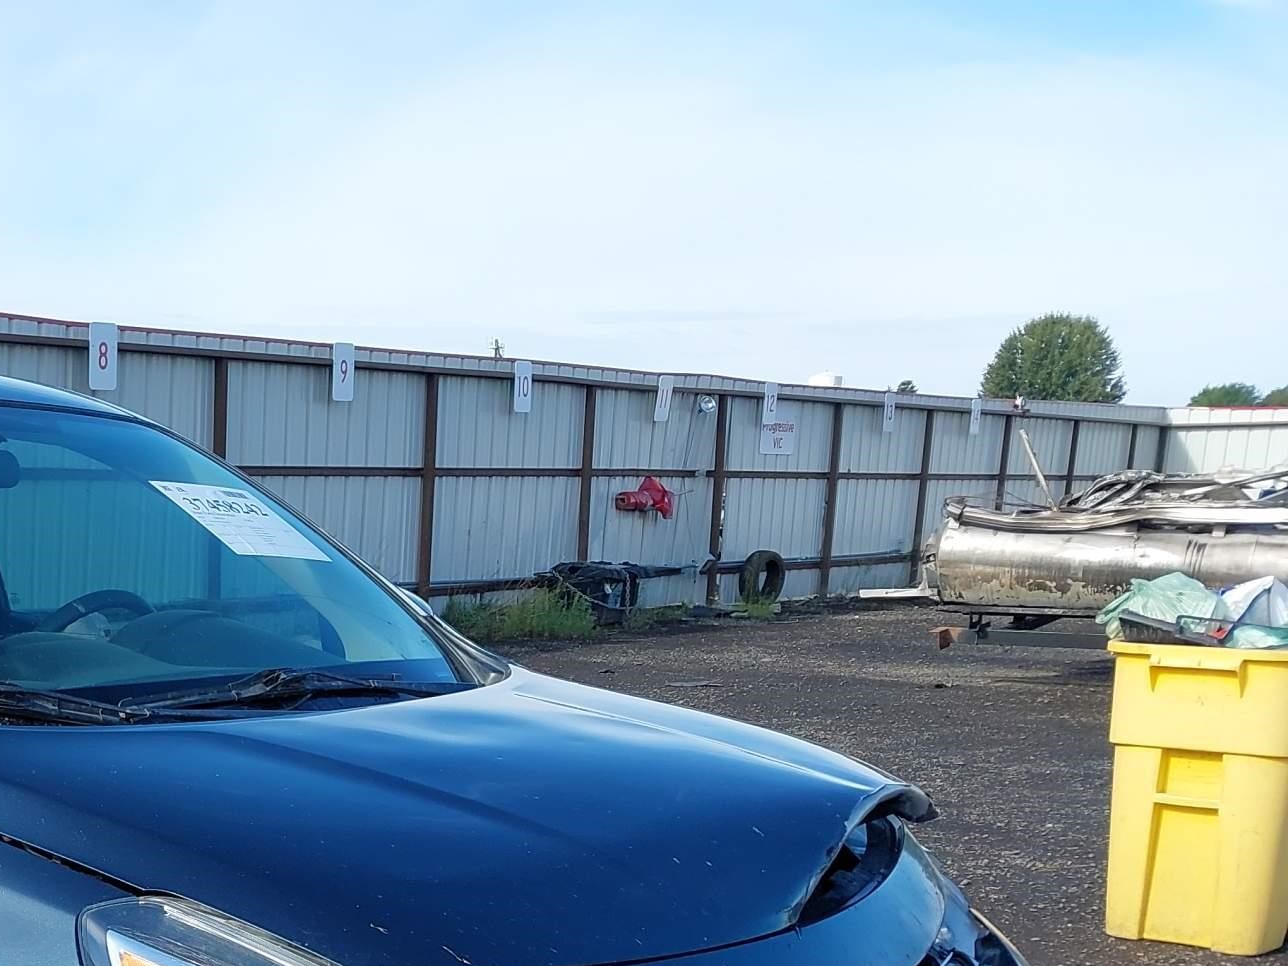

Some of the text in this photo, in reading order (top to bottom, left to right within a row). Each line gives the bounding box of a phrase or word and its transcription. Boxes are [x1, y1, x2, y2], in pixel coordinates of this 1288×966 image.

[97, 341, 110, 371] 8
[340, 359, 349, 384] 9
[517, 376, 530, 398] 10
[659, 388, 669, 409] 11
[766, 394, 776, 413] 12
[181, 497, 269, 516] 37458242
